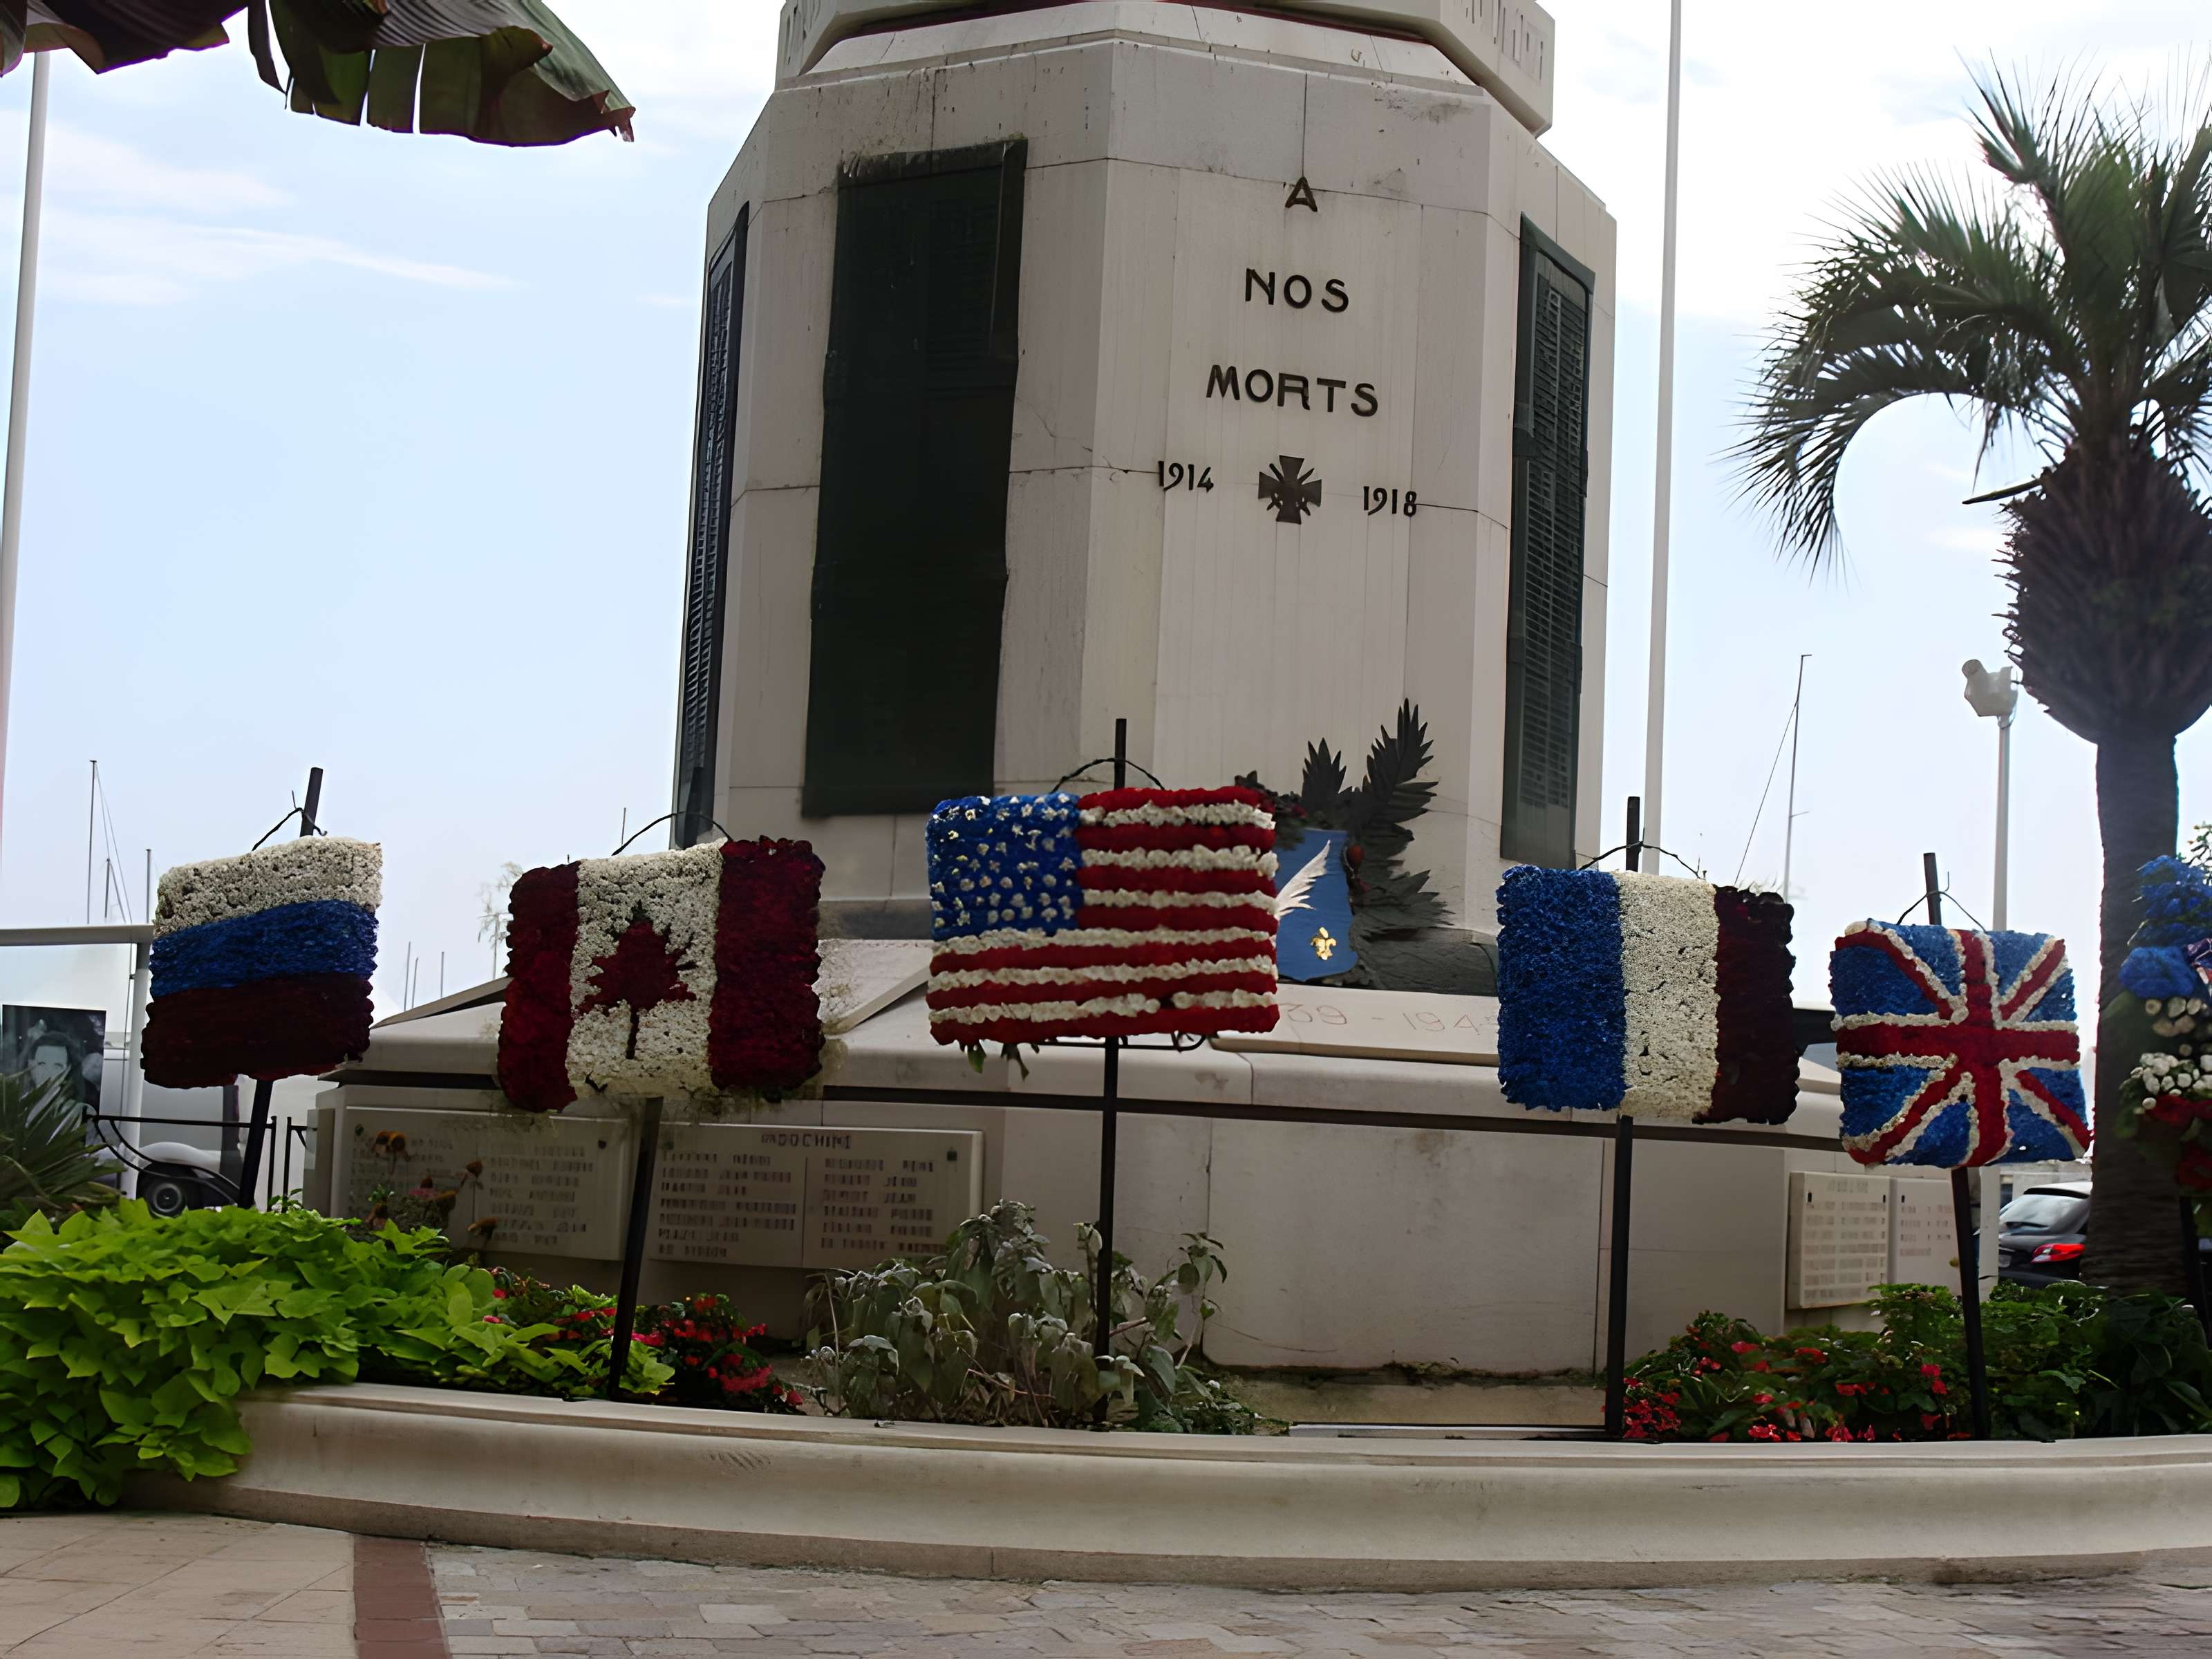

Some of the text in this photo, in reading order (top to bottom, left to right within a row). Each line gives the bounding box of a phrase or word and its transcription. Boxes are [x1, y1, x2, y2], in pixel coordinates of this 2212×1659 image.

[1284, 176, 1318, 213] A
[1245, 268, 1349, 313] NOS
[1206, 364, 1378, 418] MORTS
[1158, 460, 1417, 518] 1914 1918
